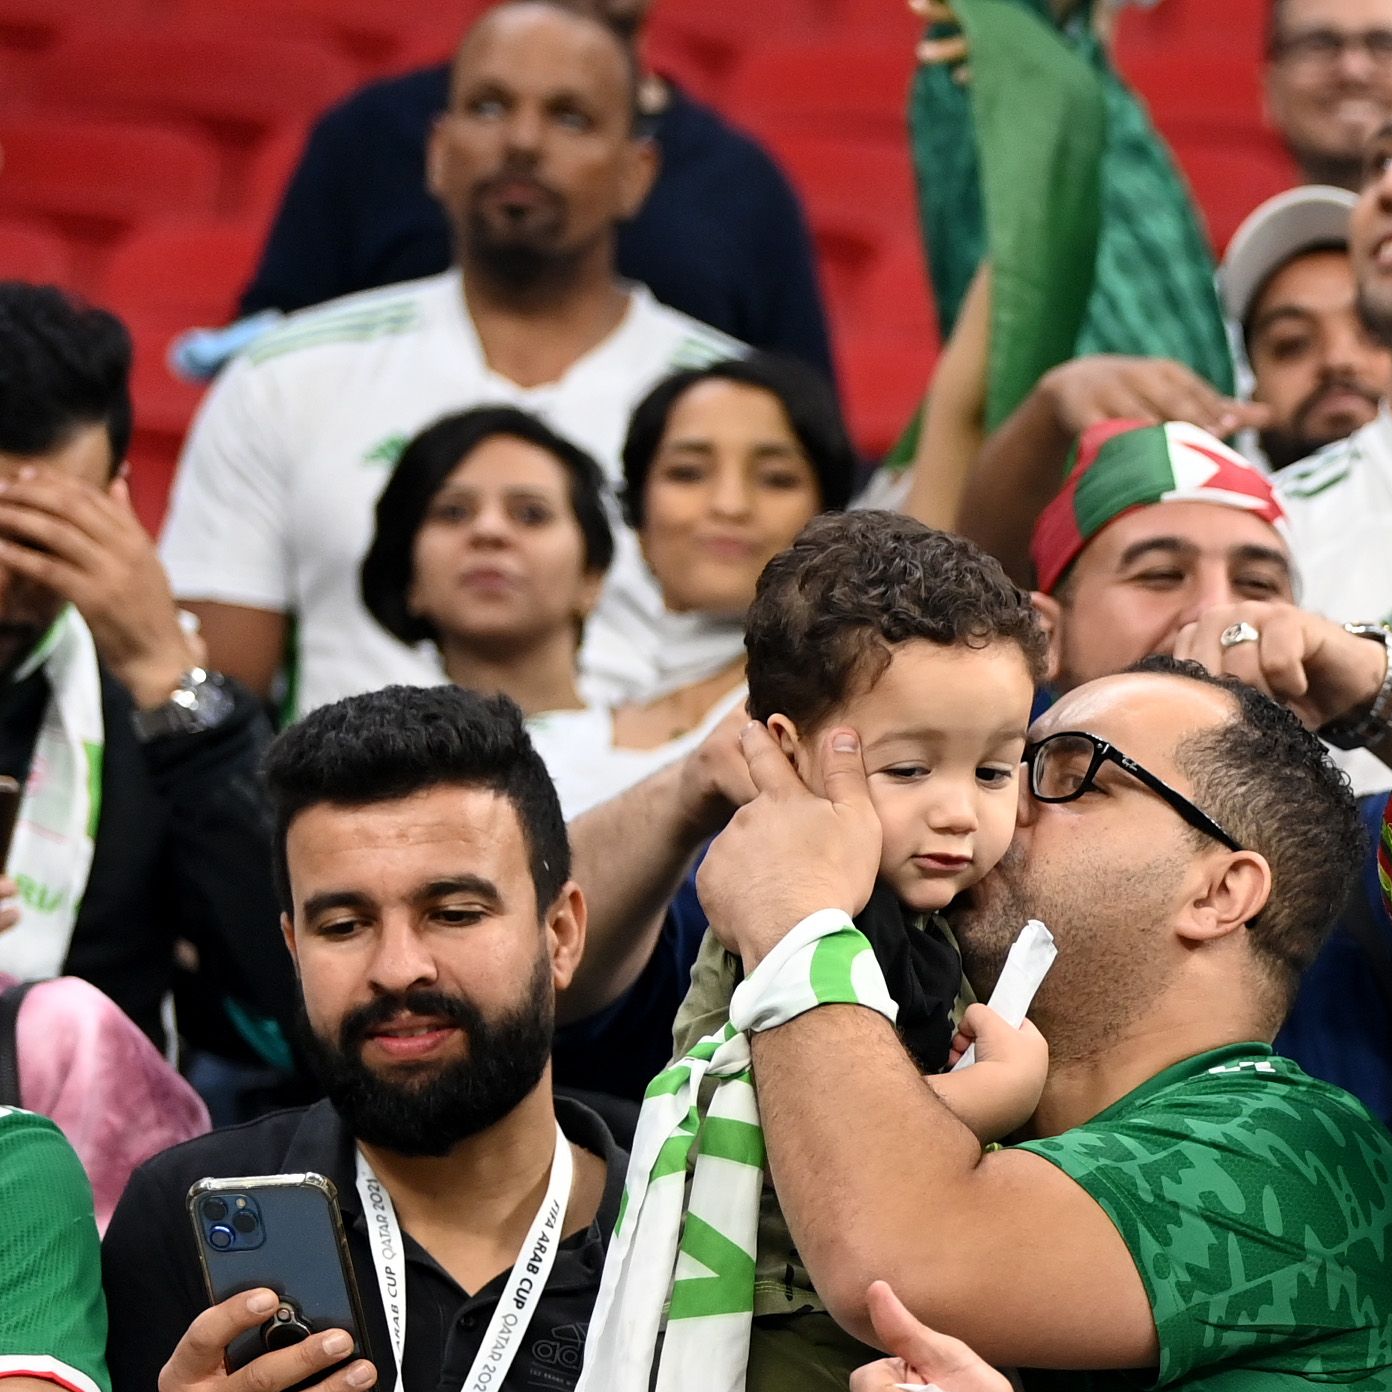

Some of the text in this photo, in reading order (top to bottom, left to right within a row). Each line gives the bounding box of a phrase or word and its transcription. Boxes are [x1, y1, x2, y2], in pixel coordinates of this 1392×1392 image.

[367, 1178, 386, 1212] 2021
[544, 1199, 560, 1230] FIFA
[376, 1215, 397, 1260] QATAR
[526, 1231, 550, 1275] ARAB
[385, 1266, 398, 1298] CUP
[513, 1278, 533, 1310] CUP
[488, 1313, 518, 1363] QATAR
